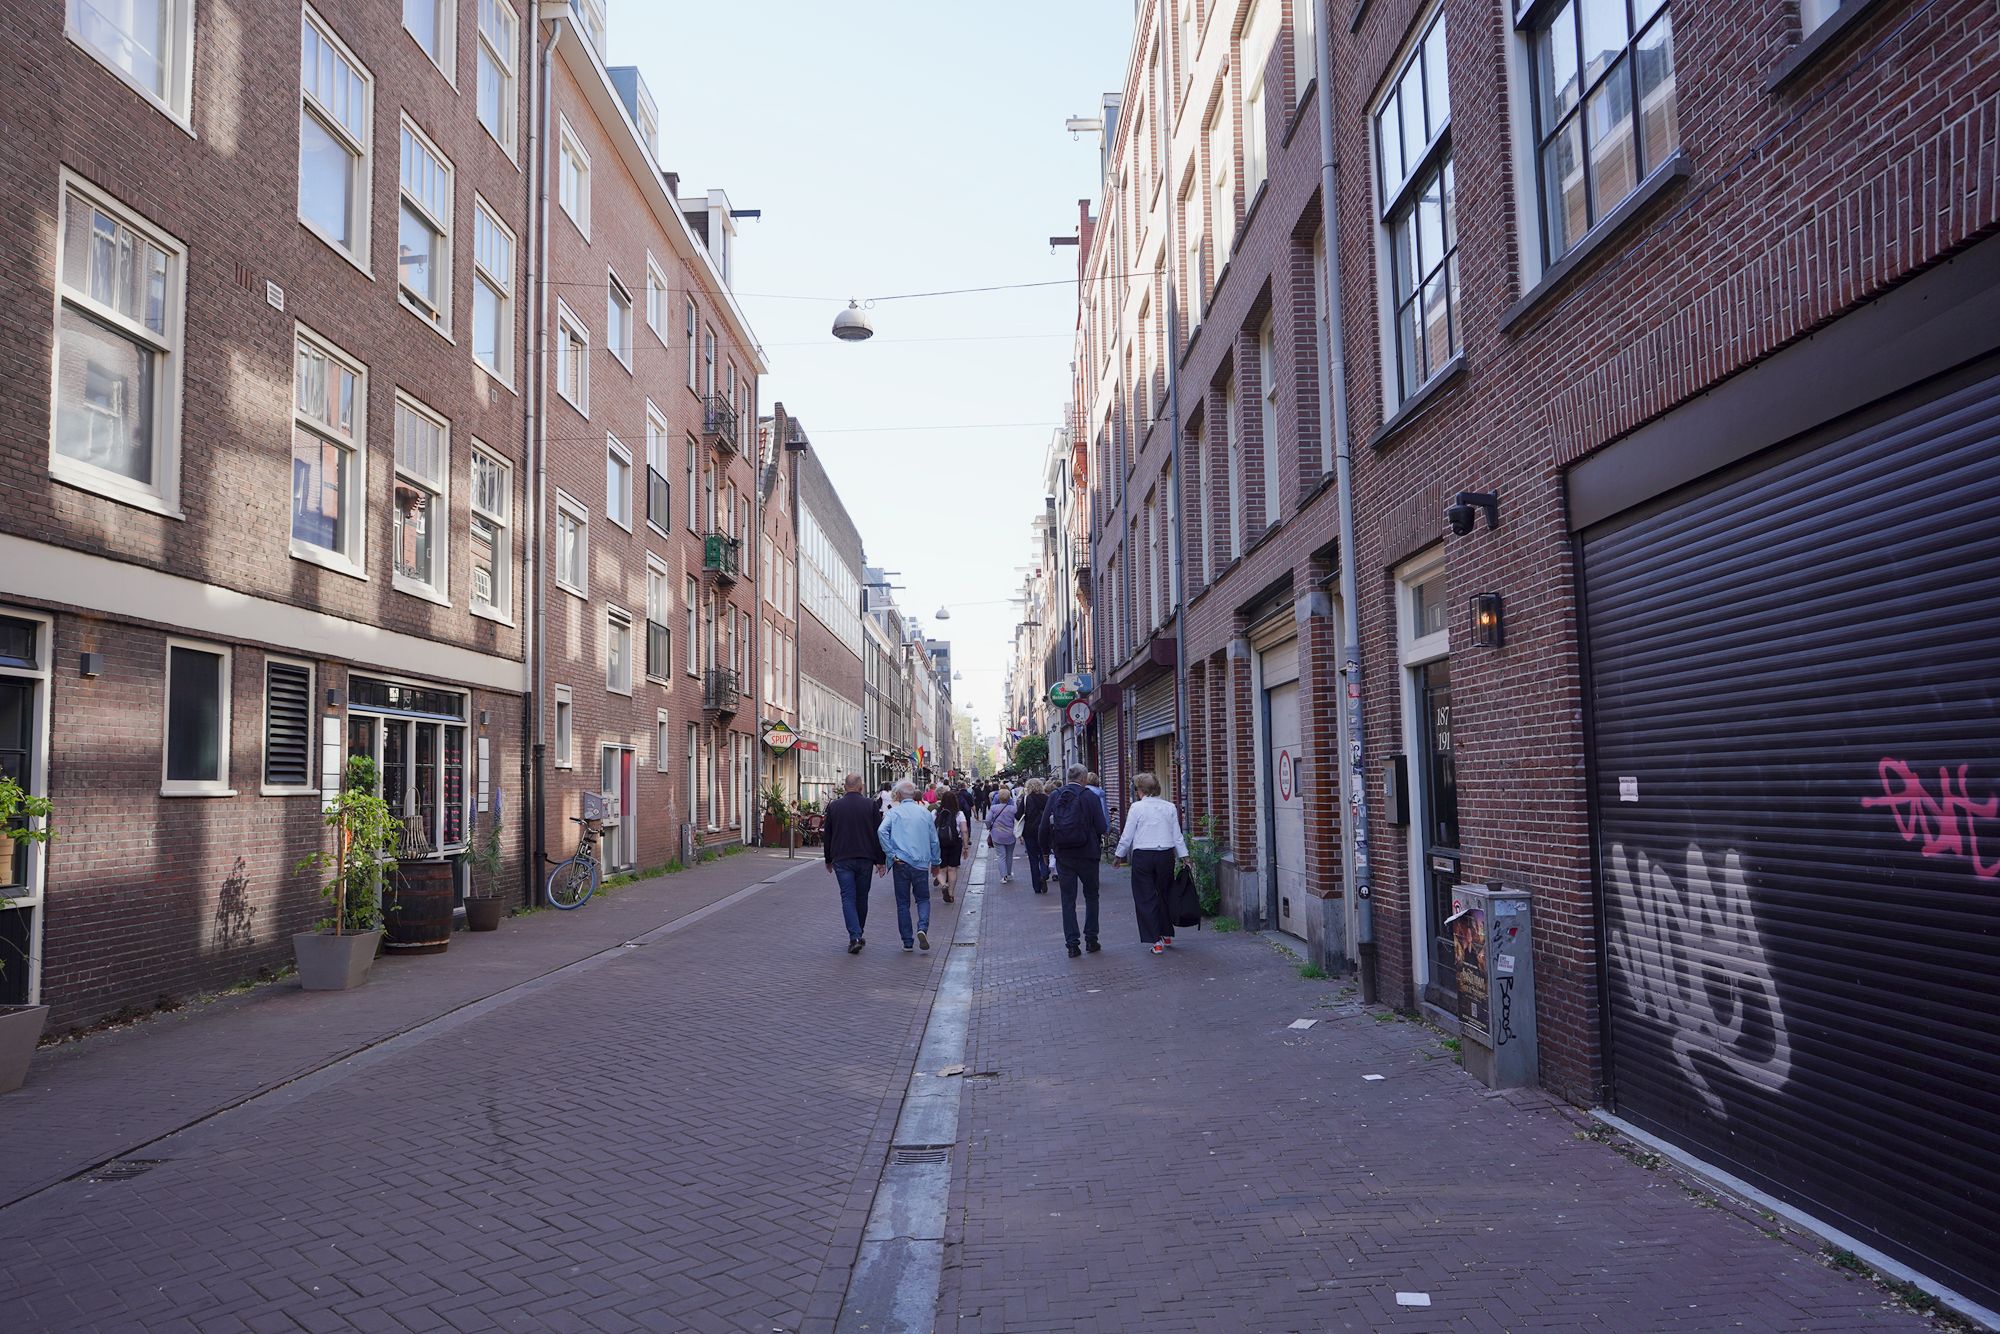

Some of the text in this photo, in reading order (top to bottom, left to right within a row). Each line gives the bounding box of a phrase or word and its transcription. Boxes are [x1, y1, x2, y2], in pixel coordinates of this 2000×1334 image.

[1437, 706, 1450, 726] 187
[771, 734, 793, 745] SPUYT
[1438, 731, 1451, 750] 191
